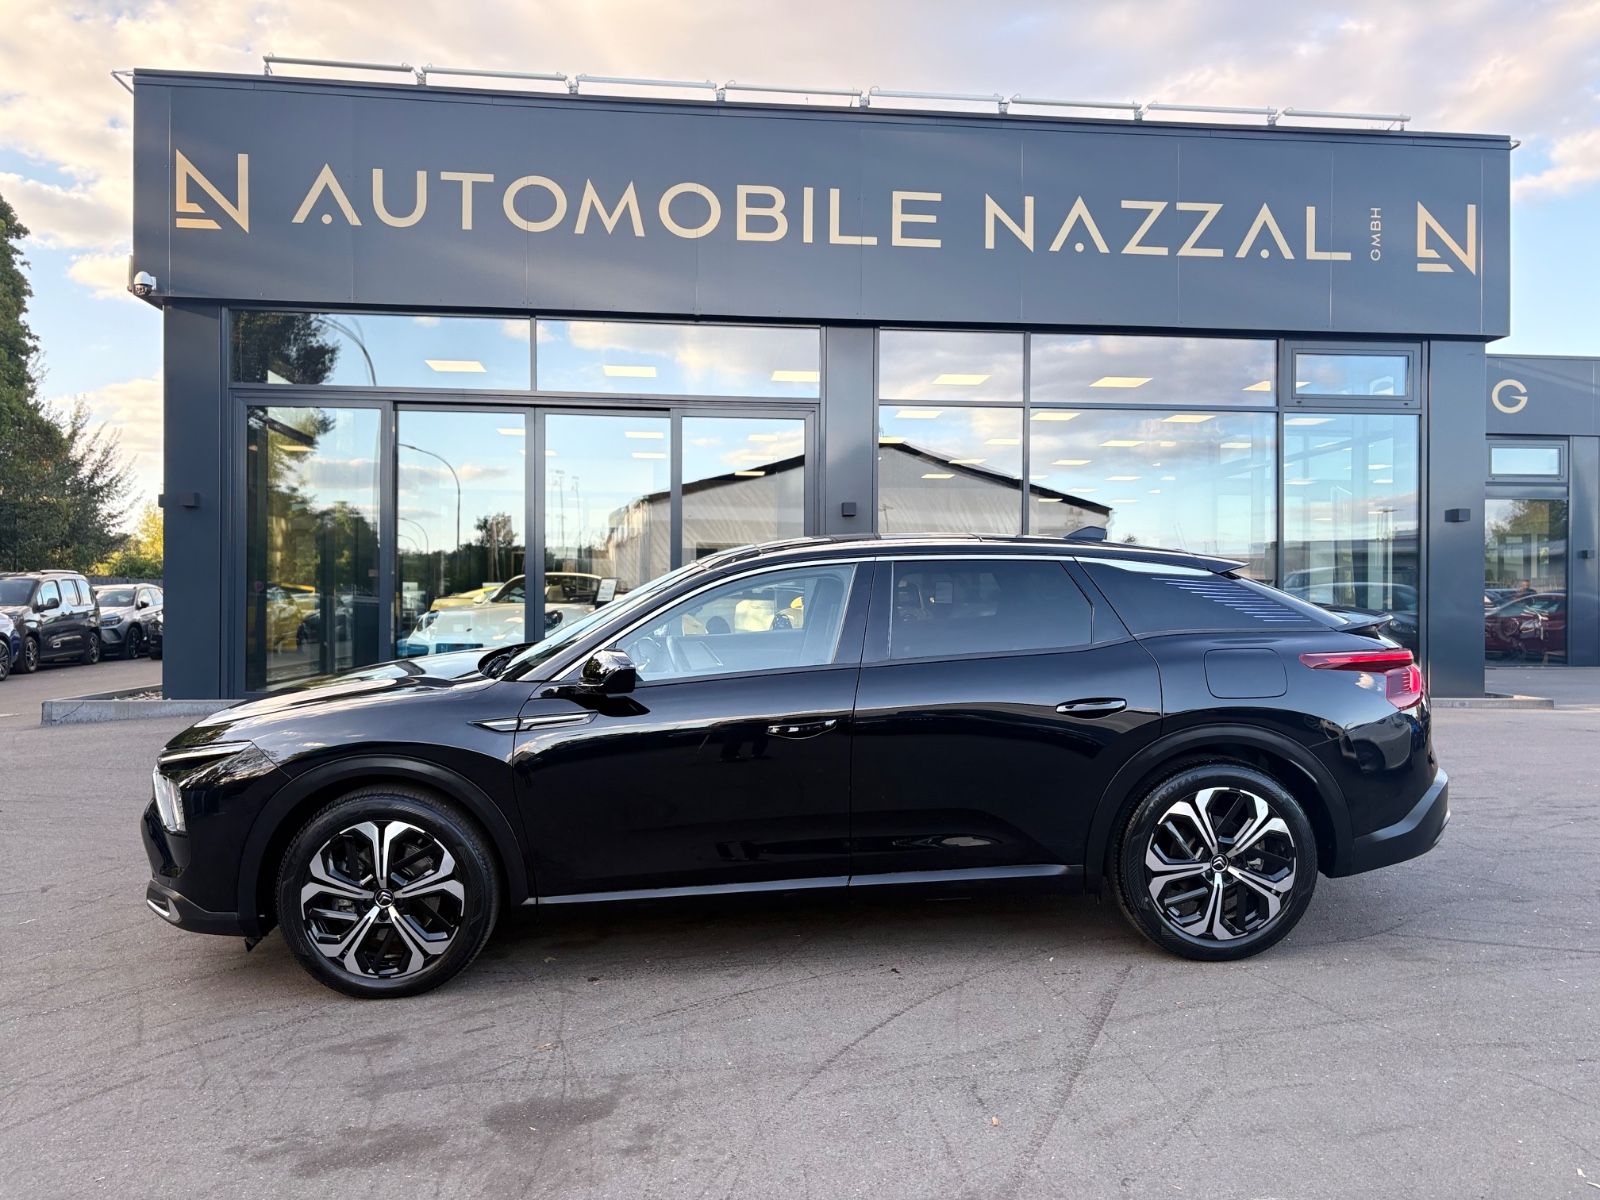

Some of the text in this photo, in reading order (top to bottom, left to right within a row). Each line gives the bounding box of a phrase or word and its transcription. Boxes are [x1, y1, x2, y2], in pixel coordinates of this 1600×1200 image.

[293, 164, 1352, 262] AUTOMOBILE NAZZAL
[1370, 207, 1381, 261] GMBH
[1491, 379, 1528, 414] G
